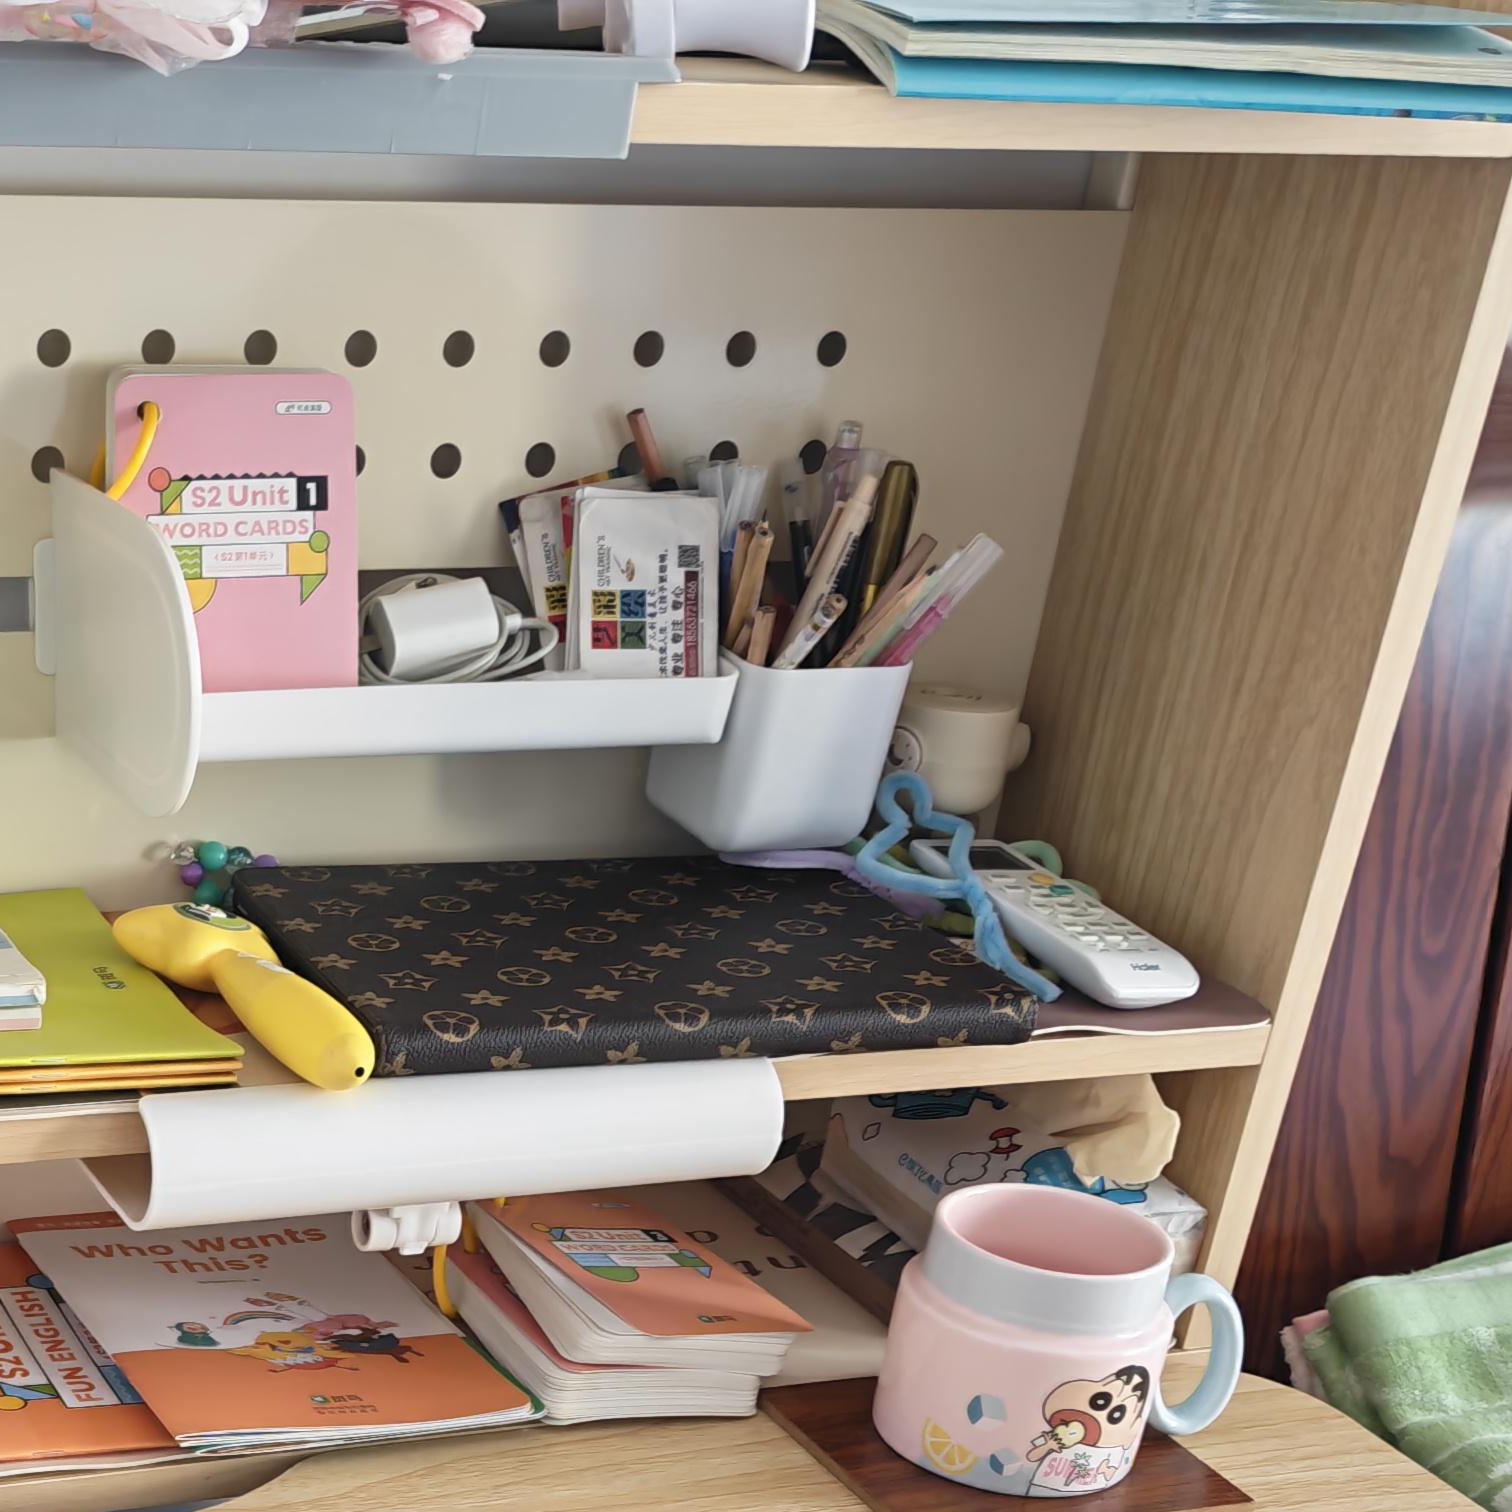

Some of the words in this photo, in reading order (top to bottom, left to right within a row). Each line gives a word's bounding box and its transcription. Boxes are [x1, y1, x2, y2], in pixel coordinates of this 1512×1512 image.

[191, 485, 221, 508] S2
[228, 484, 289, 507] Unit
[306, 482, 317, 506] 1
[234, 519, 309, 537] CARDS
[69, 1243, 174, 1259] Who
[181, 1228, 327, 1253] Wants
[153, 1254, 269, 1273] This?
[10, 1290, 77, 1362] ENGLISH
[58, 1366, 104, 1402] FUN
